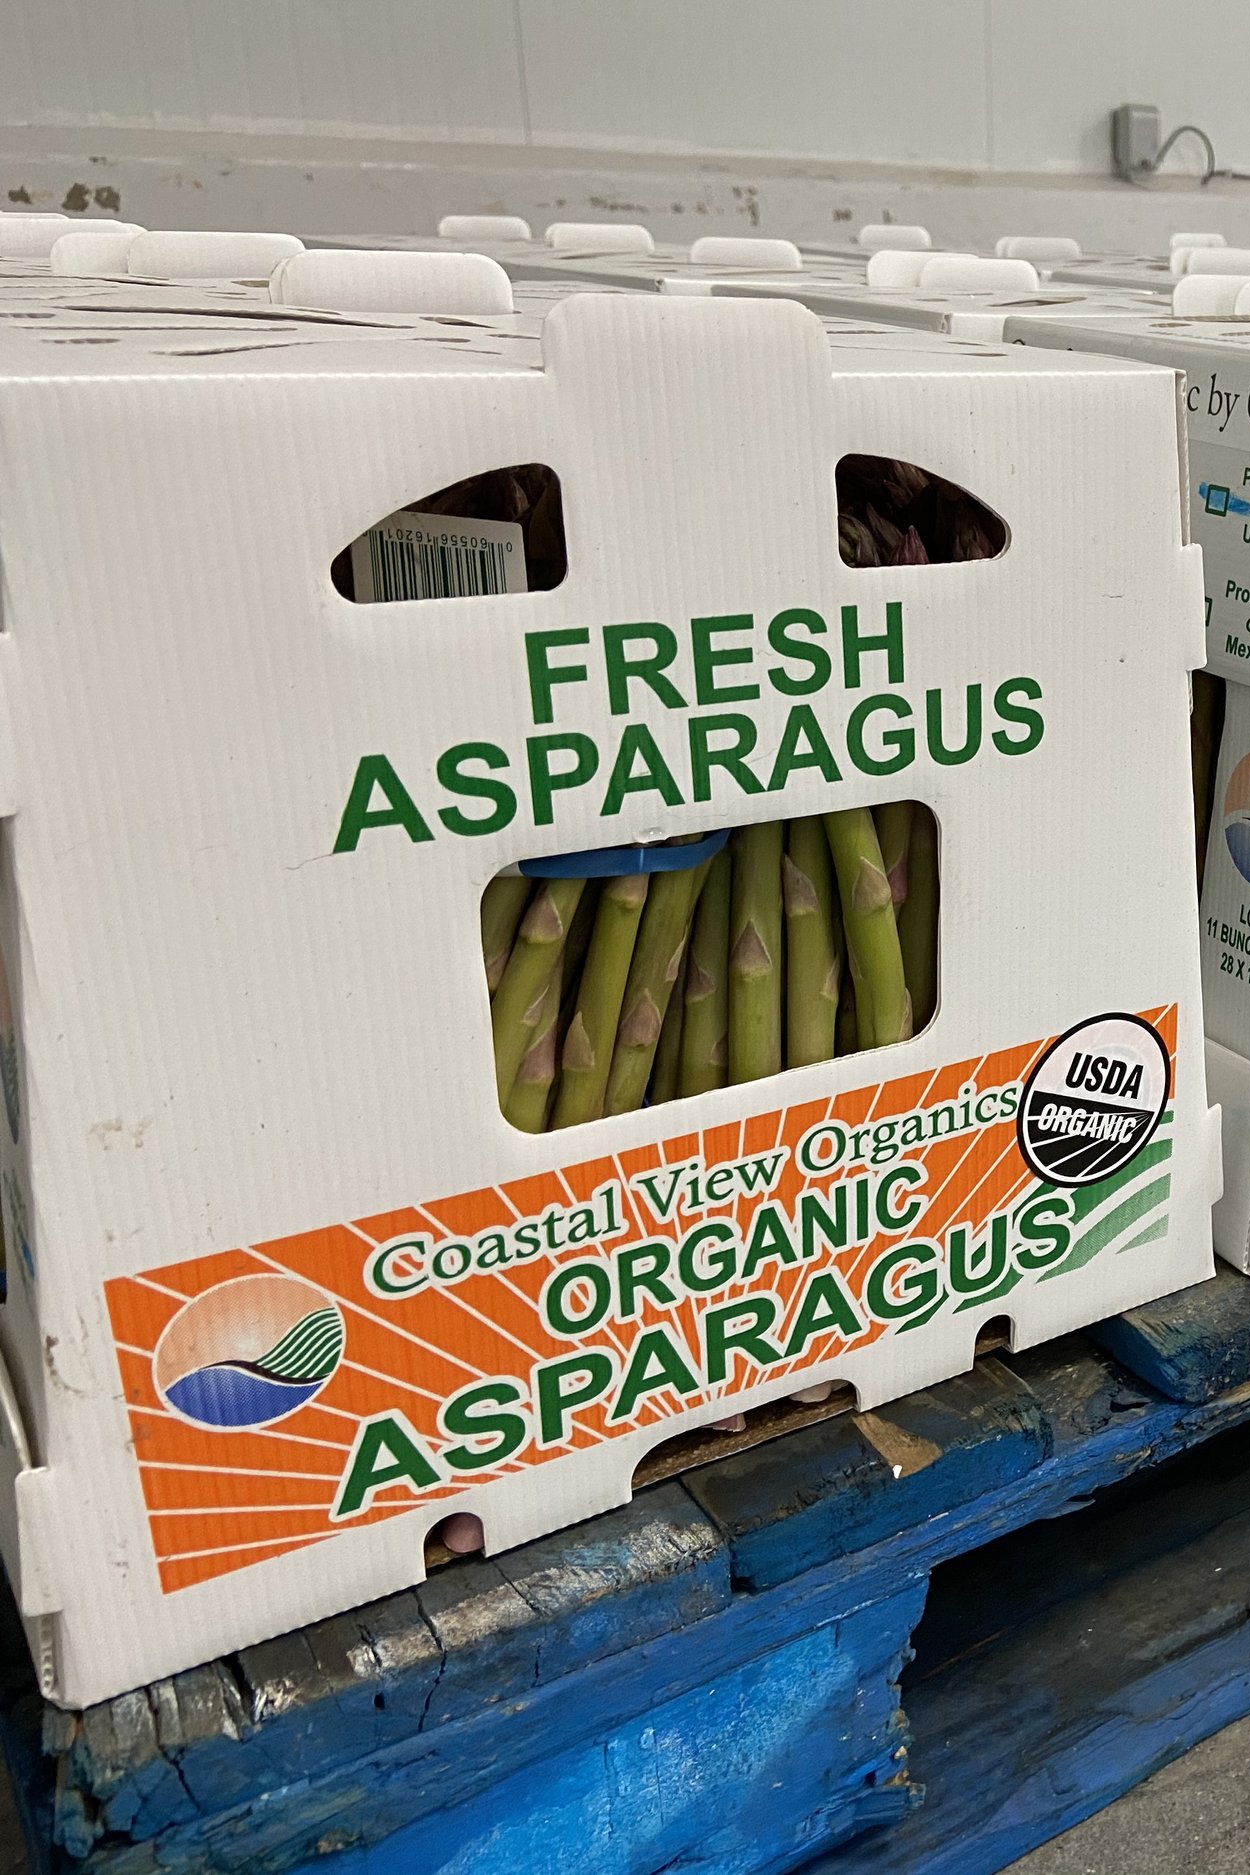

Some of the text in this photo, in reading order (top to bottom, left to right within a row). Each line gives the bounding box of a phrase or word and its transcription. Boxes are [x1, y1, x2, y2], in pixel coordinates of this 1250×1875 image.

[1208, 373, 1240, 433] by
[525, 601, 905, 724] FRESH
[332, 677, 1046, 854] ASPARAGUS
[1207, 917, 1218, 939] 11
[1220, 952, 1234, 973] 28
[1065, 1052, 1144, 1099] USDA
[1037, 1103, 1137, 1144] ORGANIC
[372, 1083, 1019, 1293] Coastal View Organics
[546, 1167, 922, 1336] ORGANIC
[334, 1198, 1078, 1518] ASPARAGUS
